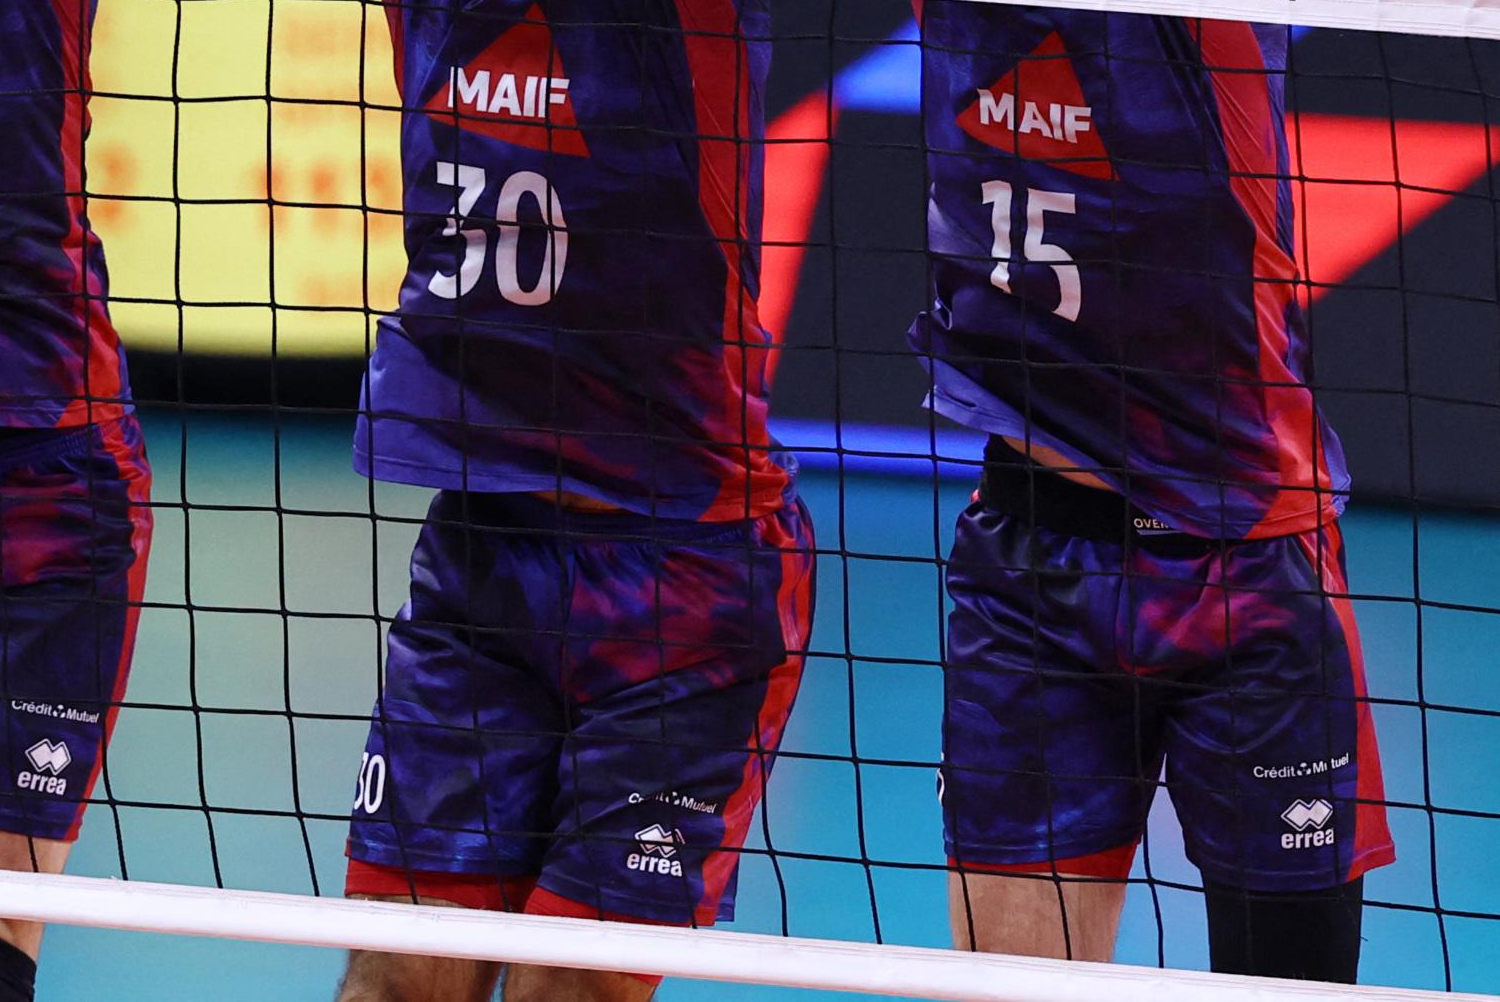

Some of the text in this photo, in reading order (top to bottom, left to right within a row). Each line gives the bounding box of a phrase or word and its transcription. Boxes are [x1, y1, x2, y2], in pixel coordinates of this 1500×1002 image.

[447, 65, 570, 119] MAIF
[976, 88, 1092, 144] MAIF
[427, 161, 569, 307] 30
[981, 179, 1082, 323] 15
[17, 771, 67, 796] errea
[1253, 765, 1296, 779] Crédit
[1281, 827, 1335, 850] errea
[626, 853, 683, 877] errea
